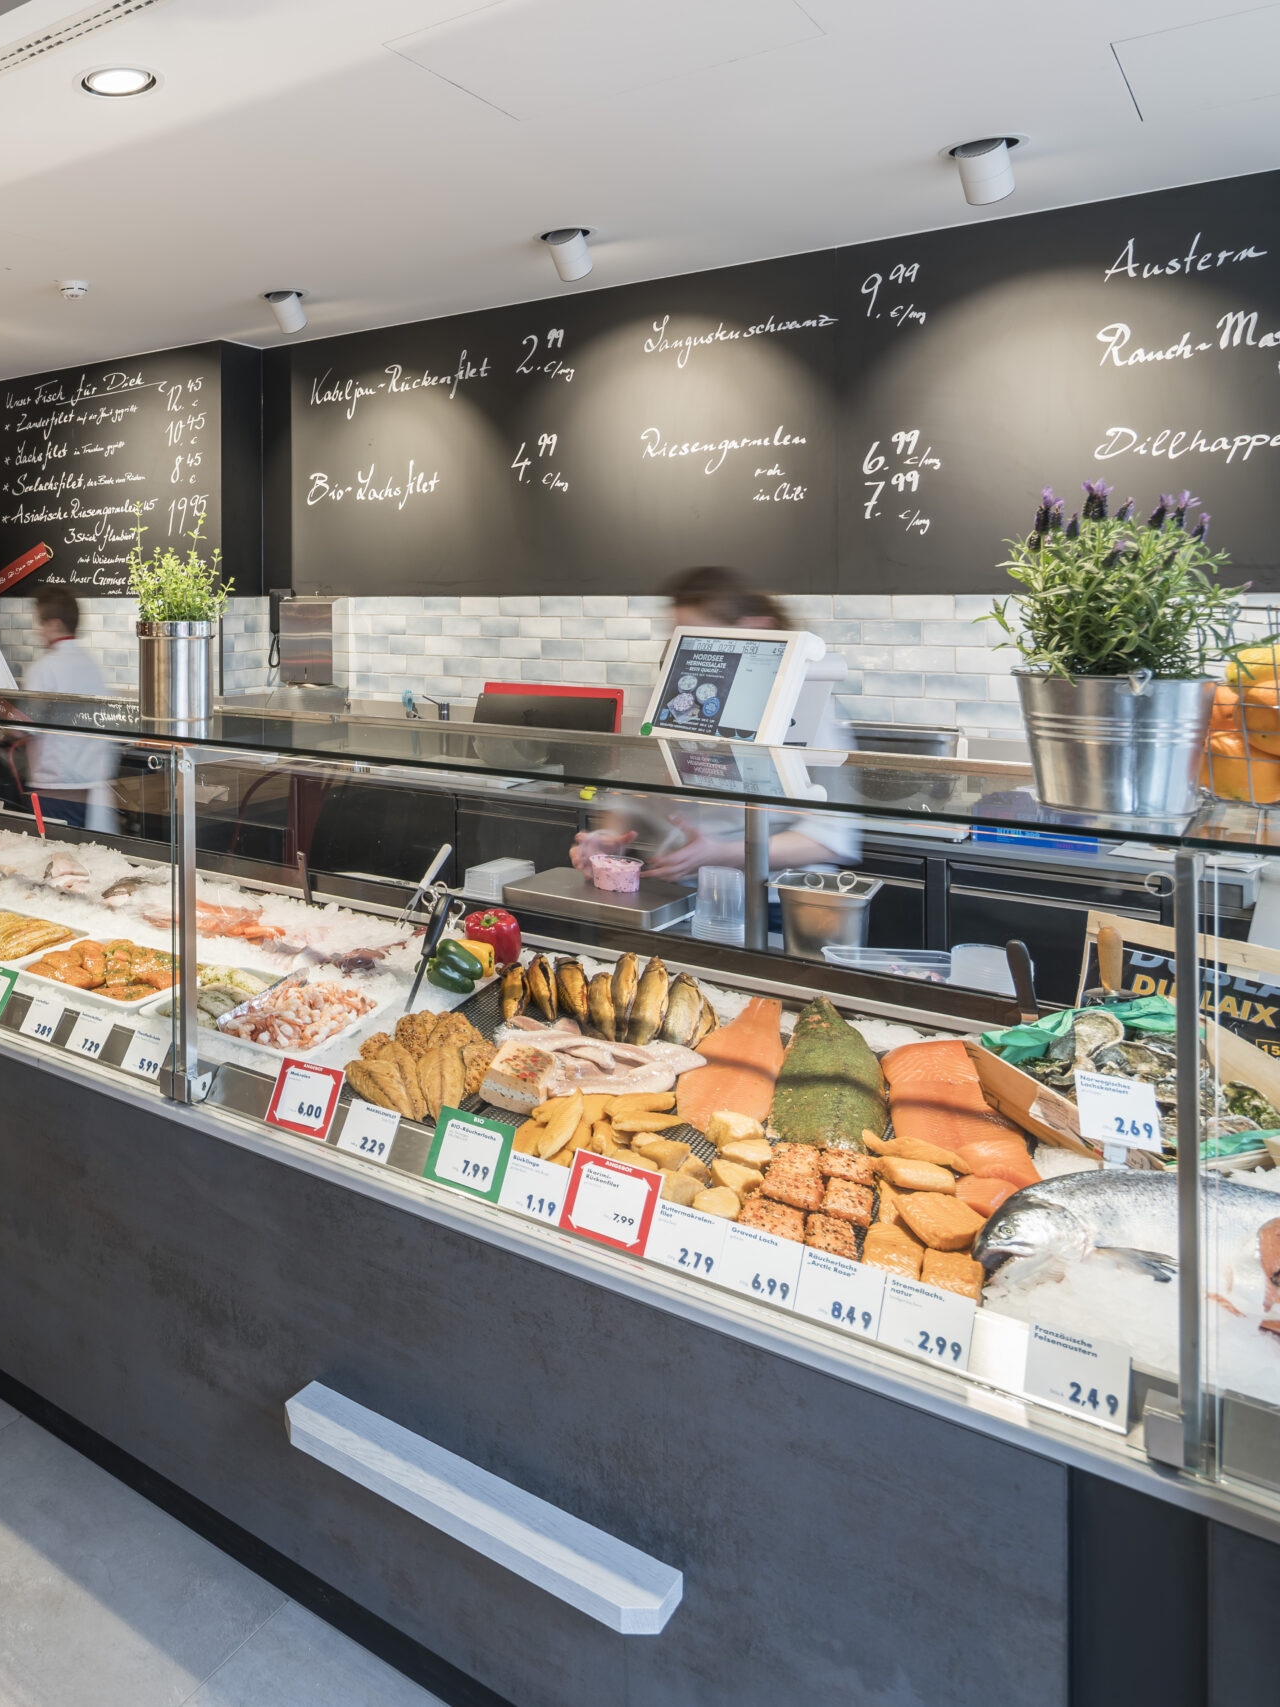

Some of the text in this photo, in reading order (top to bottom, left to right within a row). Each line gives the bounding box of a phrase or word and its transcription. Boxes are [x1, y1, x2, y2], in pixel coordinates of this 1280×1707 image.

[1104, 232, 1268, 282] Austern
[644, 314, 839, 368] Langustenschwanz
[34, 379, 66, 405] Fisch
[70, 373, 97, 406] für
[16, 409, 75, 441] Zanderfilet
[639, 426, 808, 475] Riesengarnelen
[692, 653, 725, 662] NORDSEE
[297, 1101, 322, 1119] 6,00
[473, 1116, 485, 1125] BIO
[1114, 1116, 1153, 1139] 2,69
[359, 1136, 386, 1156] 2,29
[462, 1159, 489, 1182] 7,99
[604, 1160, 633, 1173] ANGEBOT
[527, 1194, 556, 1217] 1,19
[660, 1210, 673, 1219] filet
[661, 1204, 716, 1226] Buttermakrelen-
[612, 1213, 635, 1226] 7,99
[731, 1226, 758, 1240] Graved
[758, 1235, 778, 1247] Lachs
[678, 1247, 714, 1274] 2,79
[808, 1251, 858, 1273] Räucherlachs
[751, 1273, 790, 1300] 6,99
[890, 1286, 913, 1298] natur
[831, 1301, 872, 1330] 8,49
[918, 1330, 962, 1362] 2,99
[1033, 1332, 1098, 1359] Felsenaustern
[1034, 1324, 1093, 1349] Französische
[1069, 1381, 1119, 1417] 2,49
